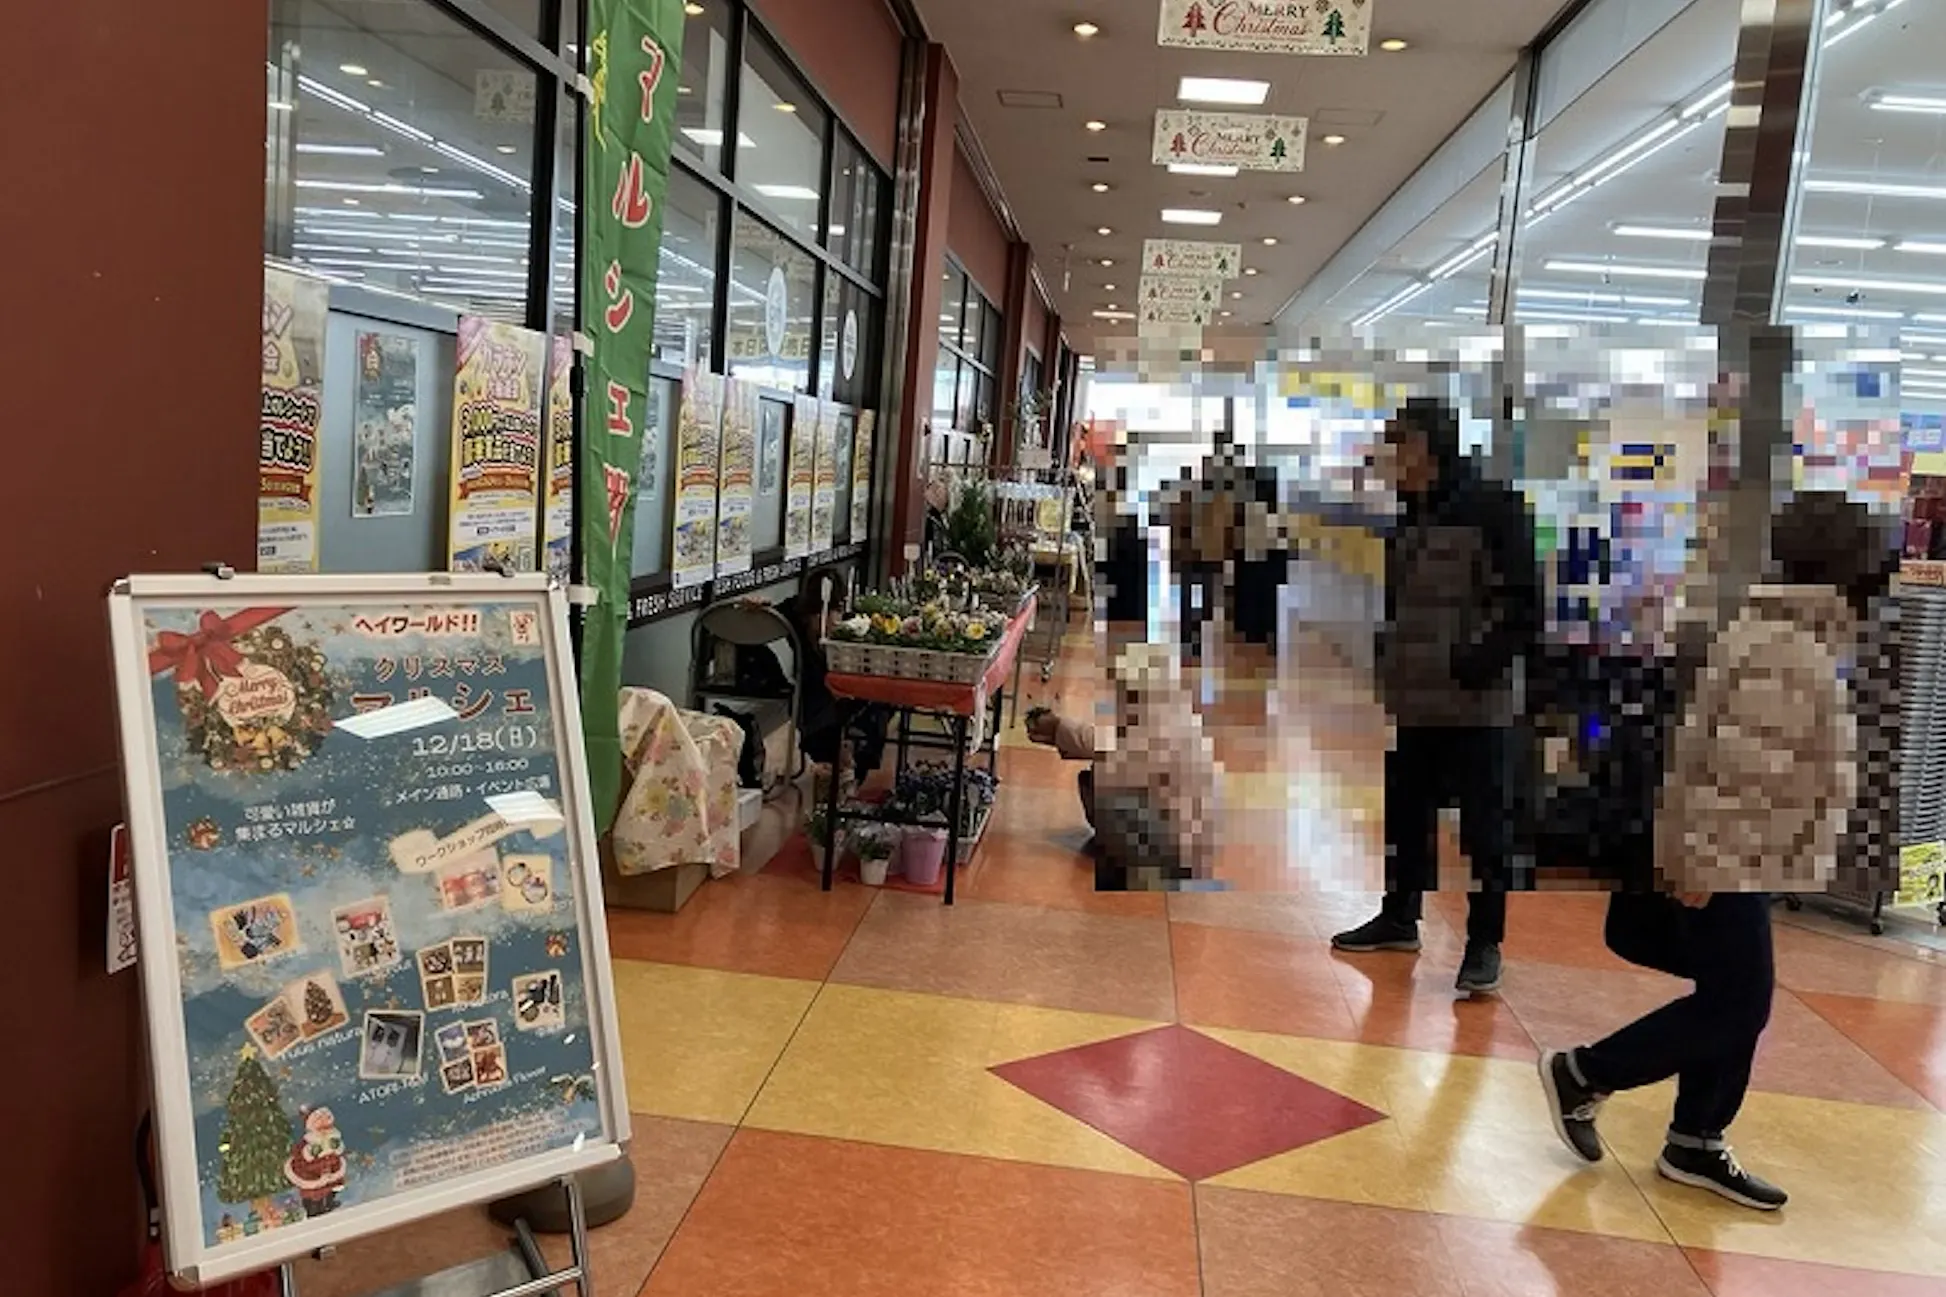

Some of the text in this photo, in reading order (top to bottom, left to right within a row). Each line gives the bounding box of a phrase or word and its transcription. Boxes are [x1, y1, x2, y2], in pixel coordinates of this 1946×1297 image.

[1213, 1, 1313, 38] Christmas
[1247, 2, 1310, 18] MERRY
[1191, 131, 1265, 159] Christmas
[1215, 131, 1260, 145] MERRY
[374, 655, 507, 683] クリスマス
[411, 725, 537, 757] 12/18(日)
